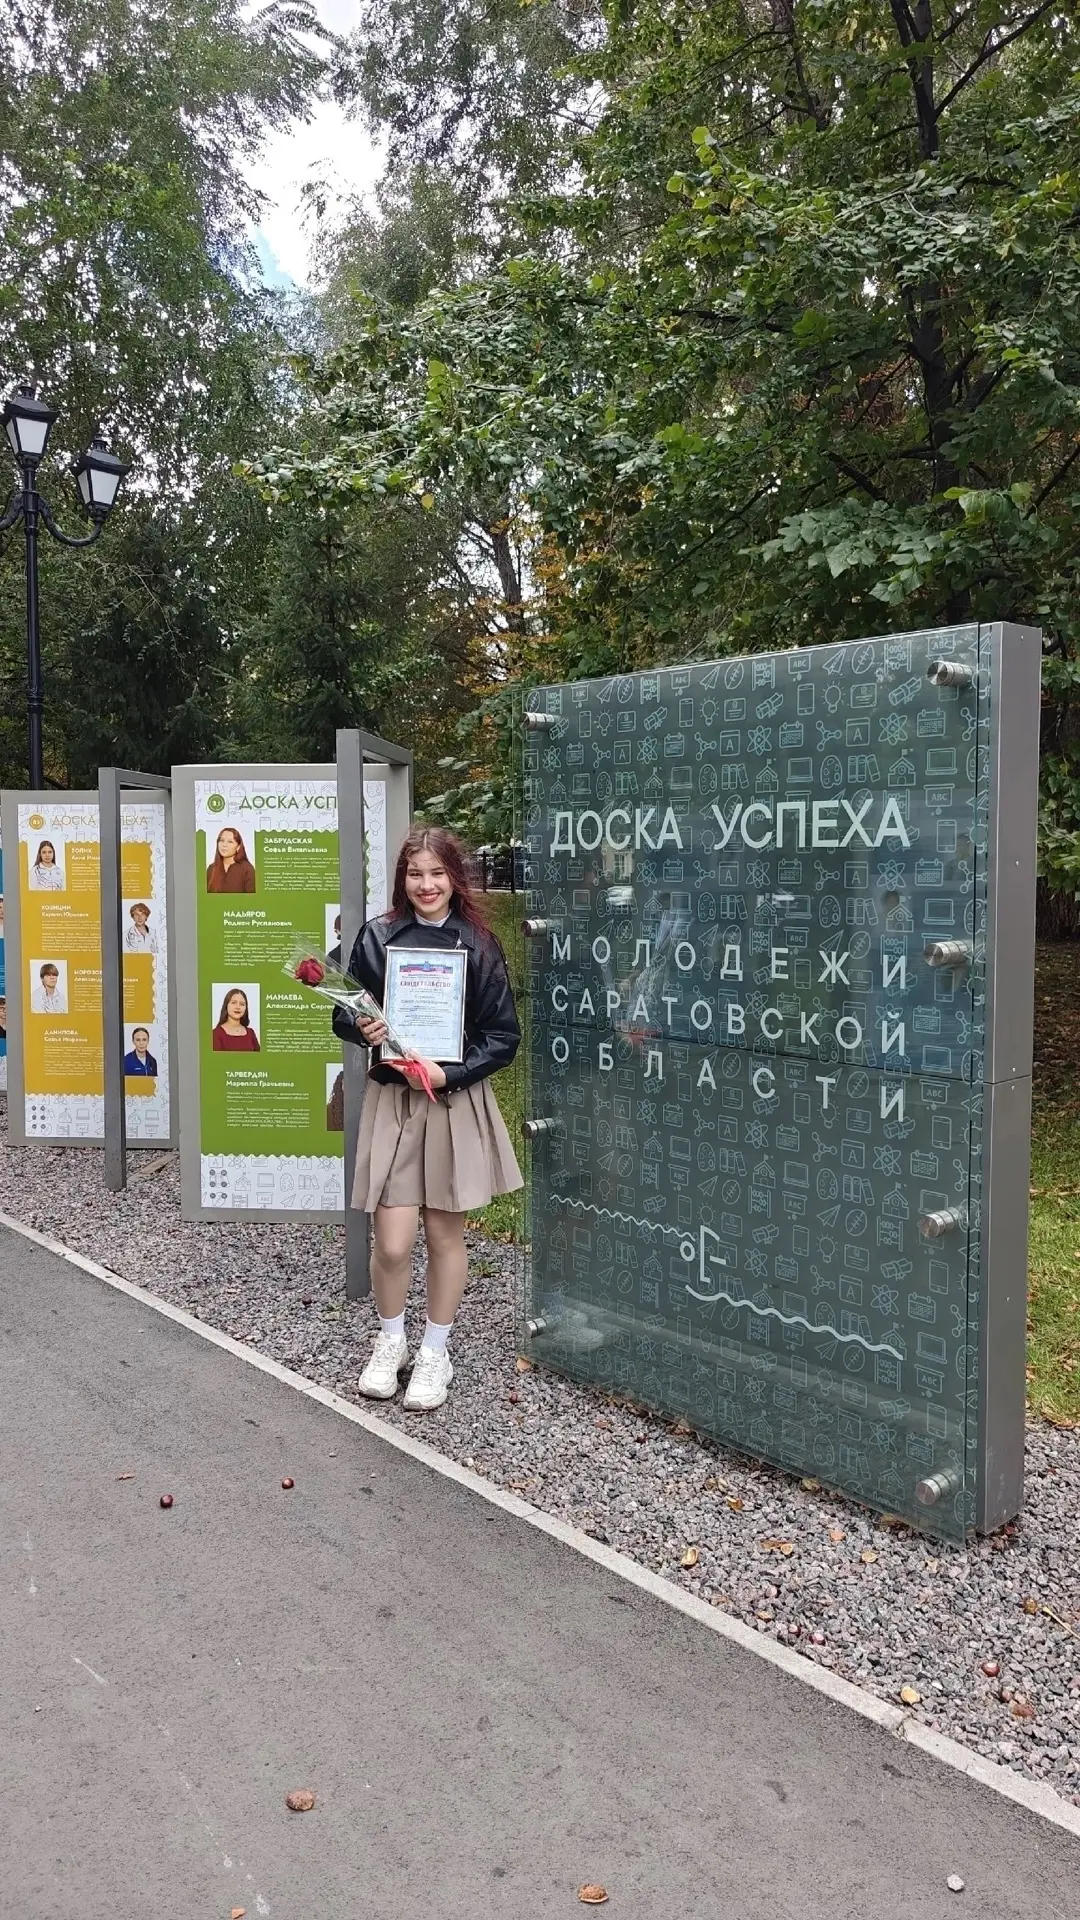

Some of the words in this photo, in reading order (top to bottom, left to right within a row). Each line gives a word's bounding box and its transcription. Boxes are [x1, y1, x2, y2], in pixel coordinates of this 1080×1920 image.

[792, 658, 808, 668] ABC
[931, 792, 948, 801] ABC
[239, 796, 299, 810] ДОСКА
[304, 796, 338, 810] УСП
[52, 815, 96, 826] ДОСКА
[550, 806, 684, 858] ДОСКА
[711, 798, 911, 850] УСПЕХА
[252, 920, 292, 928] Русланович
[790, 935, 804, 943] ABC
[552, 933, 906, 990] МОЛОДЕЖИ
[552, 985, 905, 1056] САРАТОВСКОЙ
[552, 1036, 904, 1122] ОБЛАСТИ
[927, 1089, 943, 1099] ABC
[921, 1375, 939, 1388] ABC
